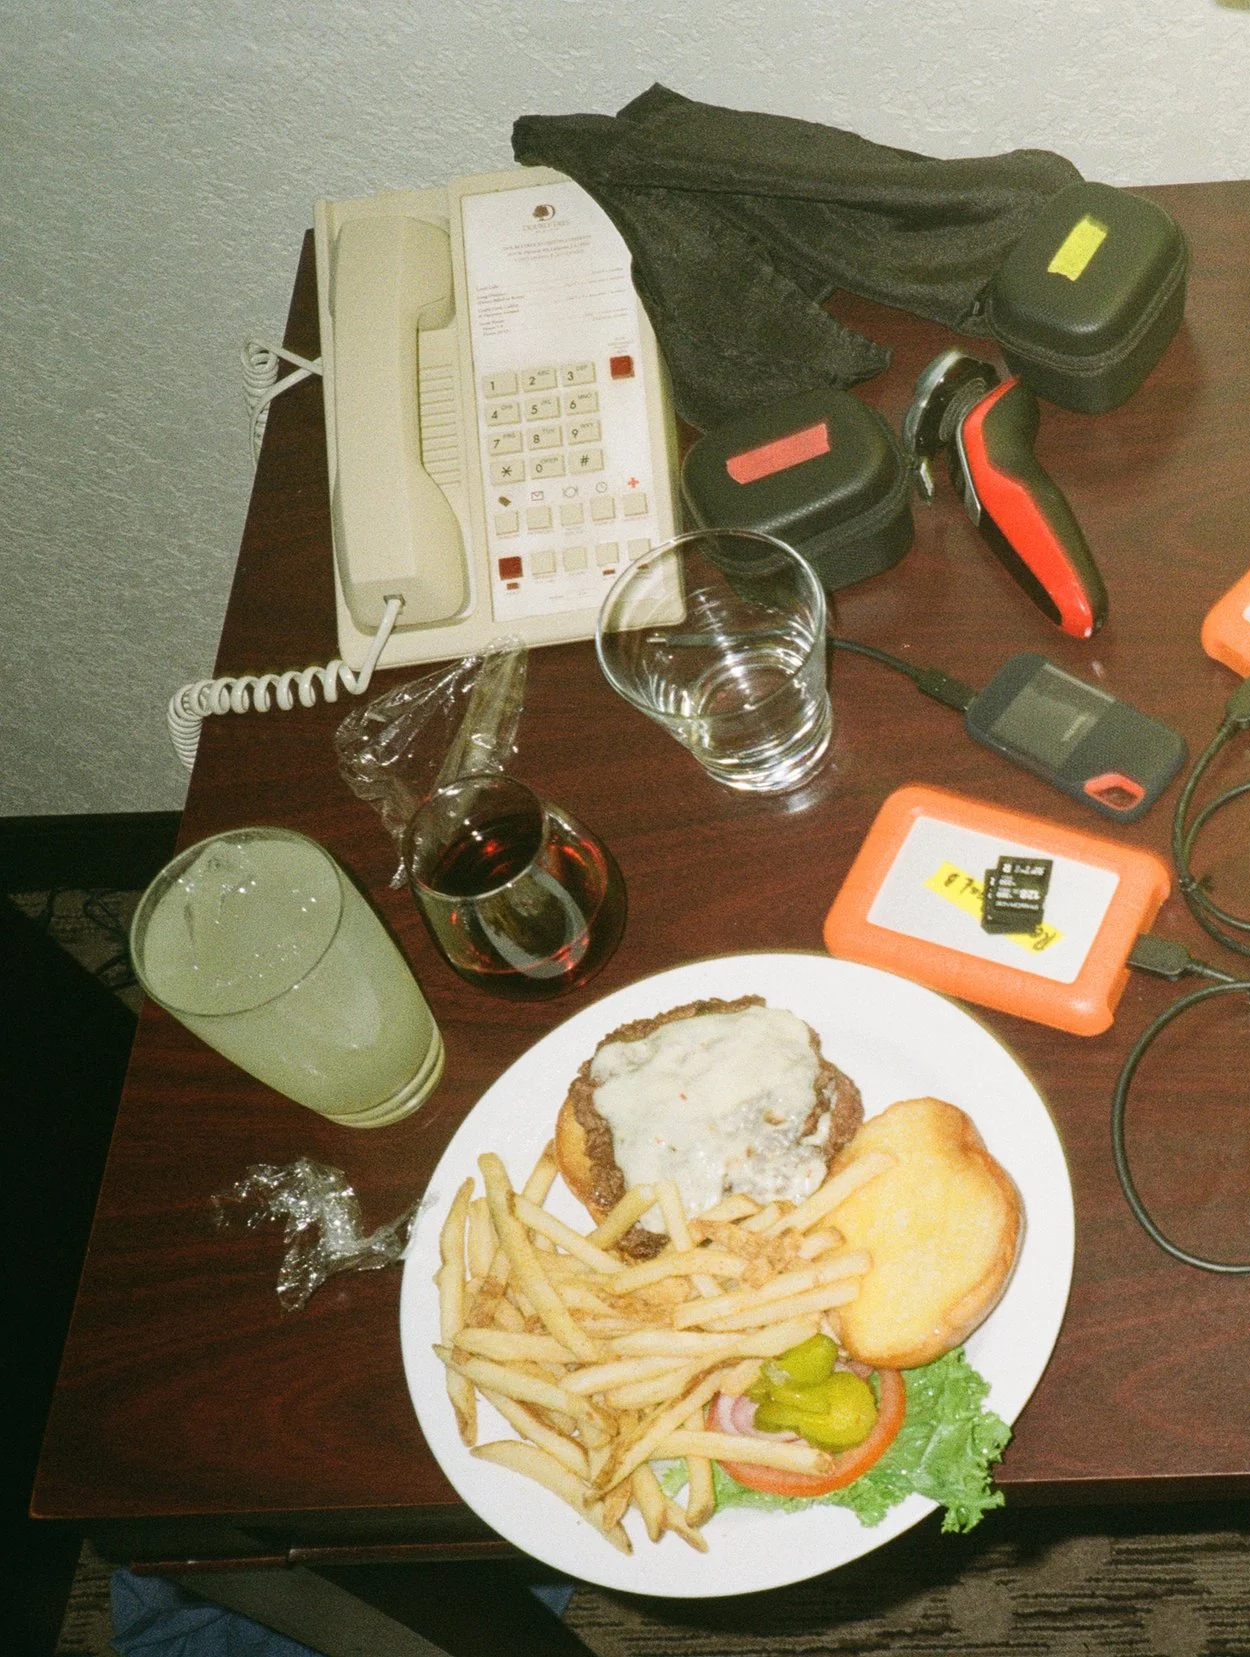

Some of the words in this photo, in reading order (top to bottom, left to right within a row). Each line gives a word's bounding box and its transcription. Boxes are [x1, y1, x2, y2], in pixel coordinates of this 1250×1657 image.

[568, 372, 574, 380] 3
[490, 381, 495, 390] 1
[529, 376, 536, 386] 2
[531, 404, 538, 414] 5
[570, 400, 576, 410] 6
[491, 410, 498, 419] 4
[572, 429, 578, 438] 9
[494, 439, 500, 448] 7
[534, 434, 540, 444] 8
[580, 455, 589, 466] #
[536, 464, 543, 473] 0
